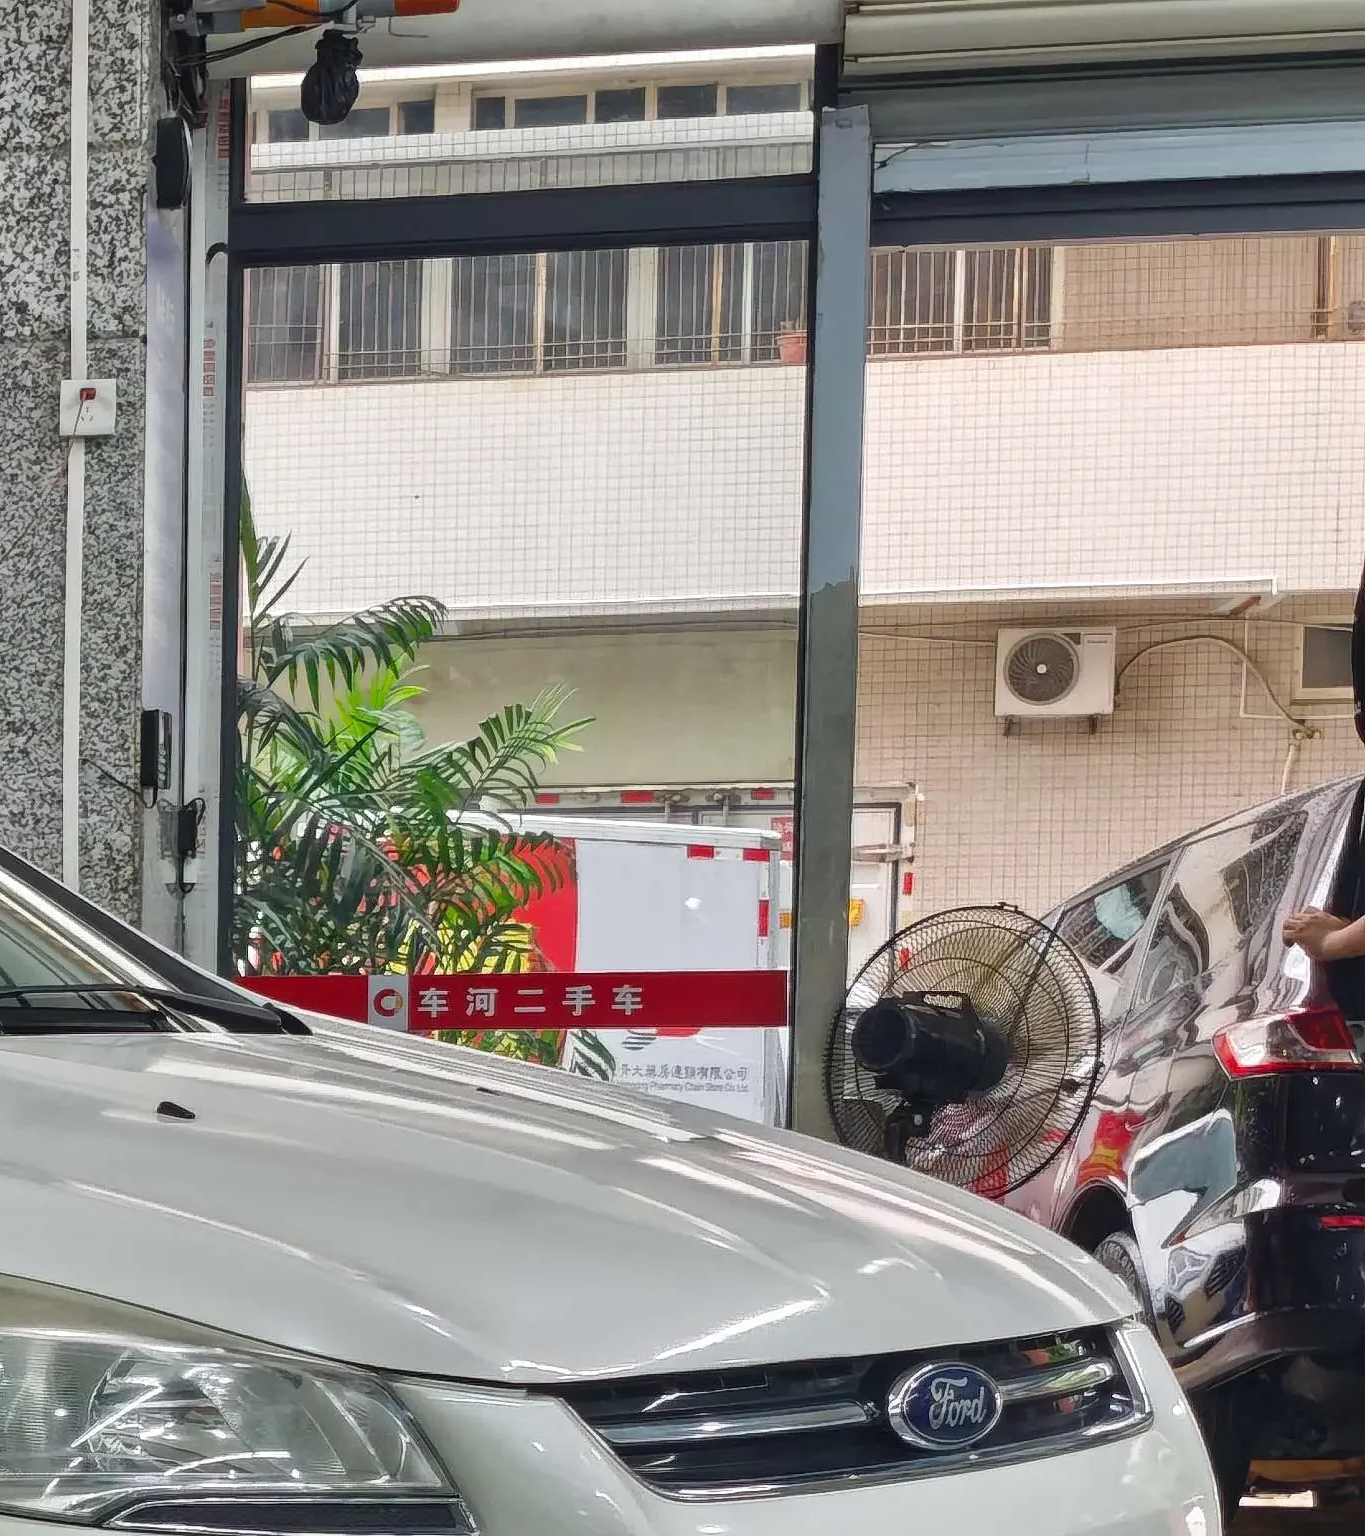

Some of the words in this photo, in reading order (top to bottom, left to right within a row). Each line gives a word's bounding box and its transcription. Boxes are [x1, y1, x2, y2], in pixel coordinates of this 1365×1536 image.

[417, 984, 643, 1018] 车河二手车
[929, 1376, 987, 1430] Ford
